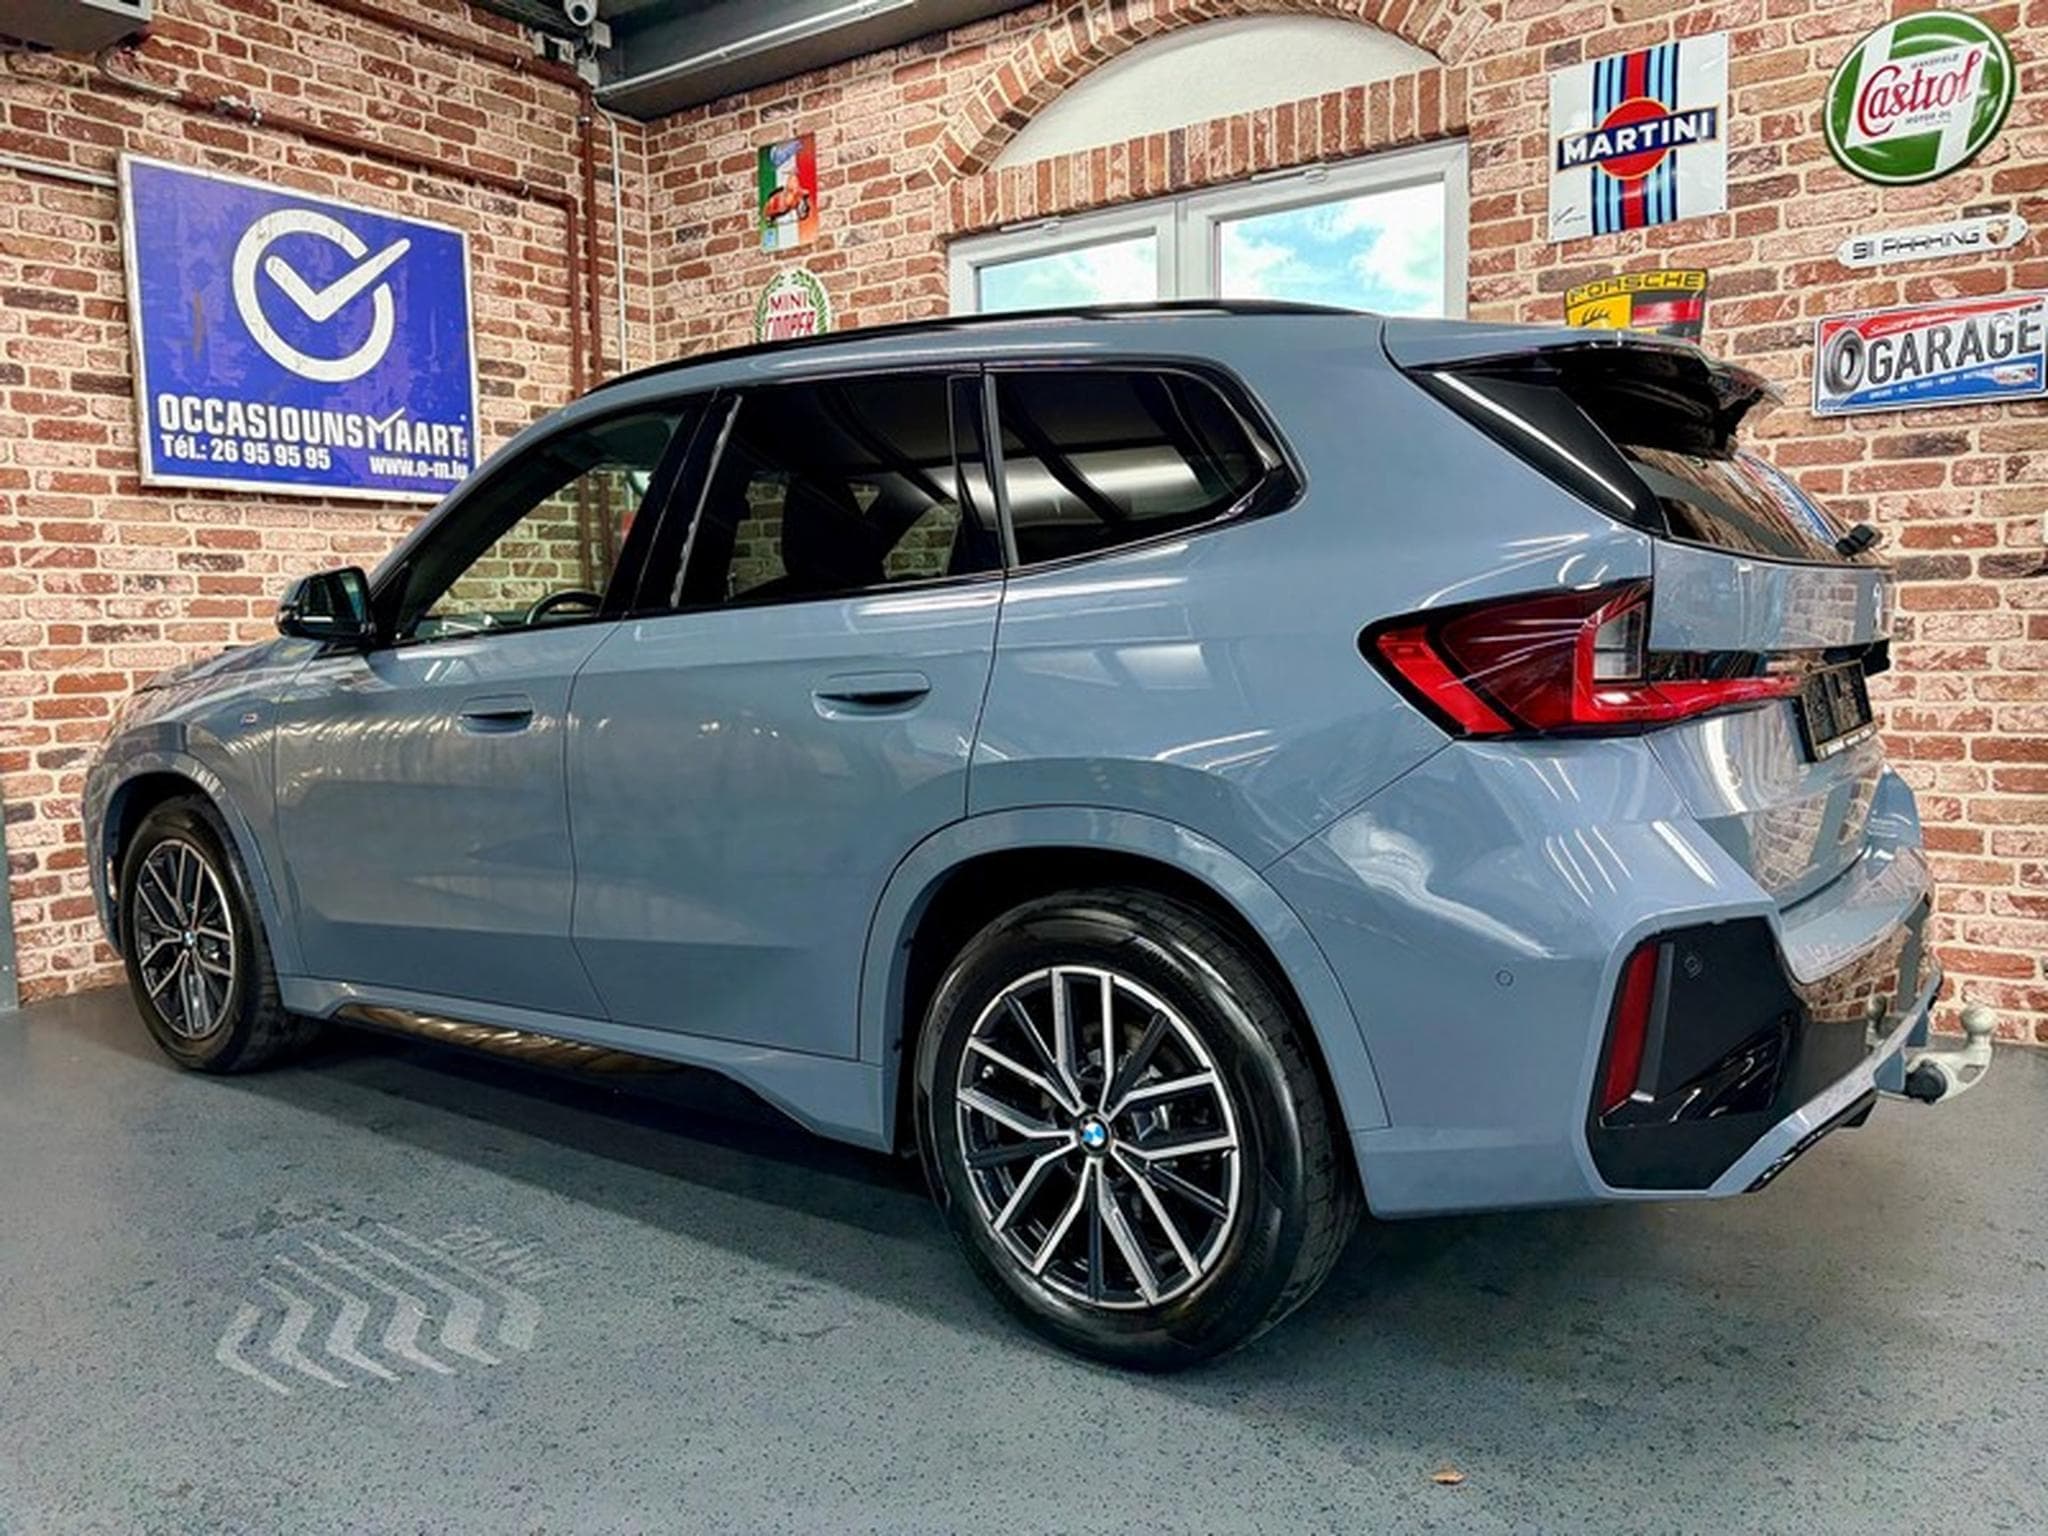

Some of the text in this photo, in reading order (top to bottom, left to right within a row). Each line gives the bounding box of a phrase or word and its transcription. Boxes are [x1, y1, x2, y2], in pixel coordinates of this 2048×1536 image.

[1857, 49, 1983, 138] Castrol
[1563, 111, 1710, 166] MARTINI
[1881, 227, 1980, 256] PARKING
[770, 291, 807, 311] MINI
[1569, 273, 1701, 303] PORSCHE
[1868, 304, 2043, 385] GARAGE
[210, 437, 239, 462] 26
[242, 440, 270, 465] 95
[273, 443, 301, 468] 95
[304, 446, 331, 471] 95
[369, 455, 469, 480] www.o-m.lu
